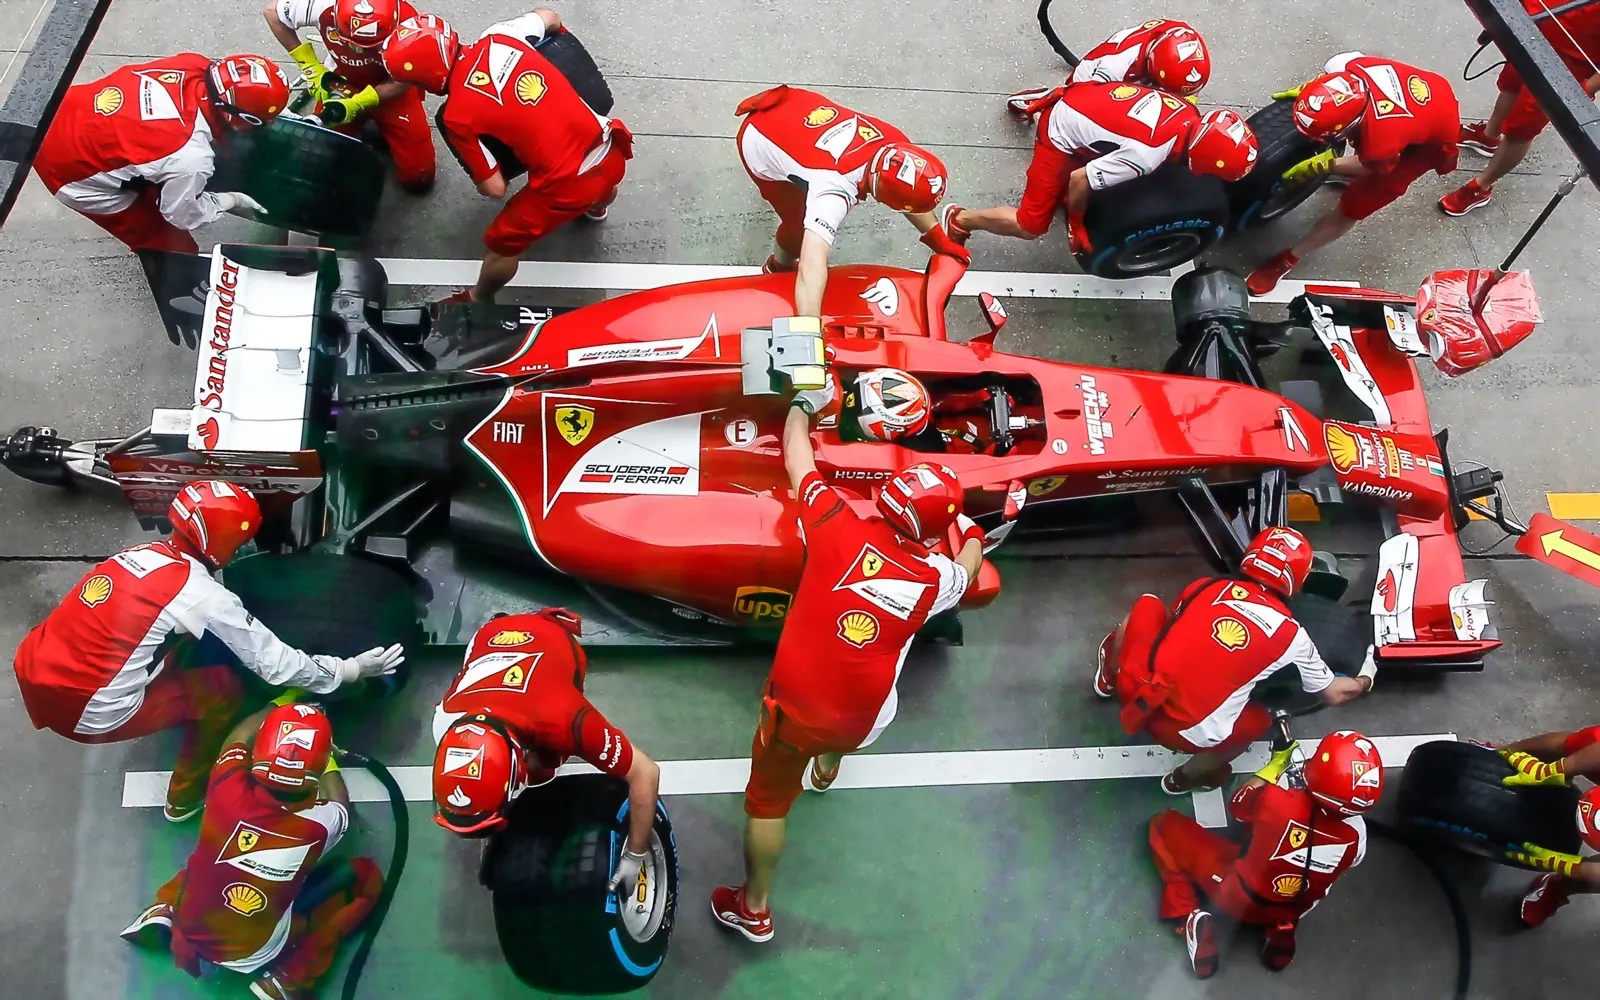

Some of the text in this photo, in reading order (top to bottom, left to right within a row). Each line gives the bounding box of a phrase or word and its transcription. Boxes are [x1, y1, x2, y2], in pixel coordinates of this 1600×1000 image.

[201, 257, 240, 413] Santander
[1079, 373, 1106, 456] WEICHAI
[493, 421, 526, 444] FIAT
[734, 420, 747, 442] E
[1357, 434, 1373, 470] TNT
[1398, 448, 1415, 471] FIAT
[583, 464, 667, 475] SCUDERIA
[613, 474, 686, 485] FERRARI
[1118, 465, 1209, 479] Santander
[737, 599, 786, 619] ups
